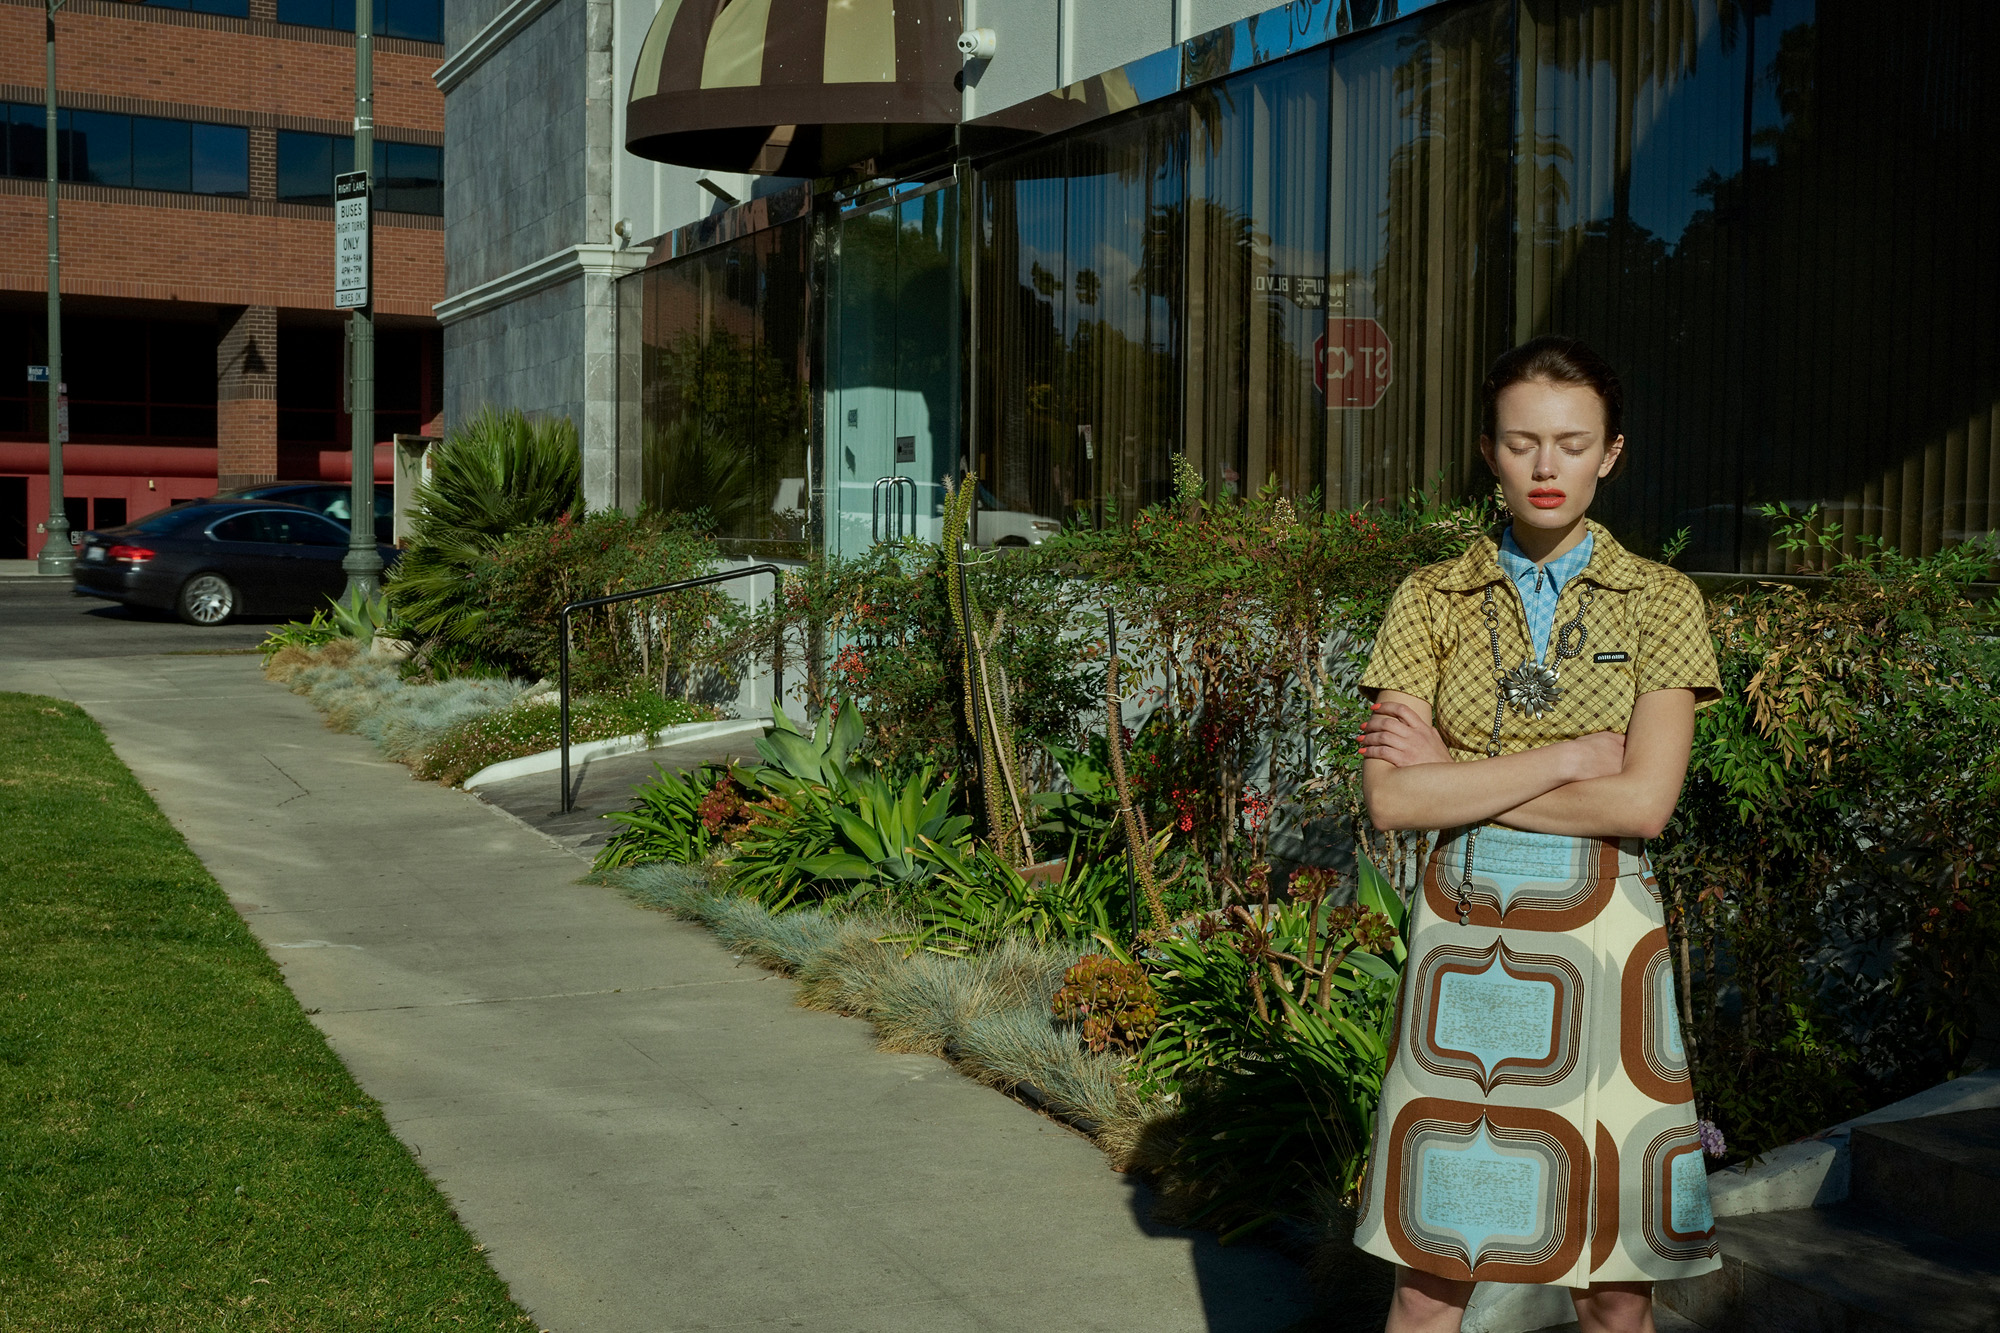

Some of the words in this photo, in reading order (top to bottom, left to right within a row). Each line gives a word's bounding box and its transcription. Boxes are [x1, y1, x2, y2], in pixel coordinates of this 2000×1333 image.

[338, 183, 351, 194] RIGHT
[353, 181, 365, 191] LANE
[341, 203, 362, 218] BUSES
[337, 222, 350, 233] RIGHT
[352, 220, 365, 232] TURNS
[343, 236, 360, 251] ONLY
[341, 293, 353, 303] BIKES
